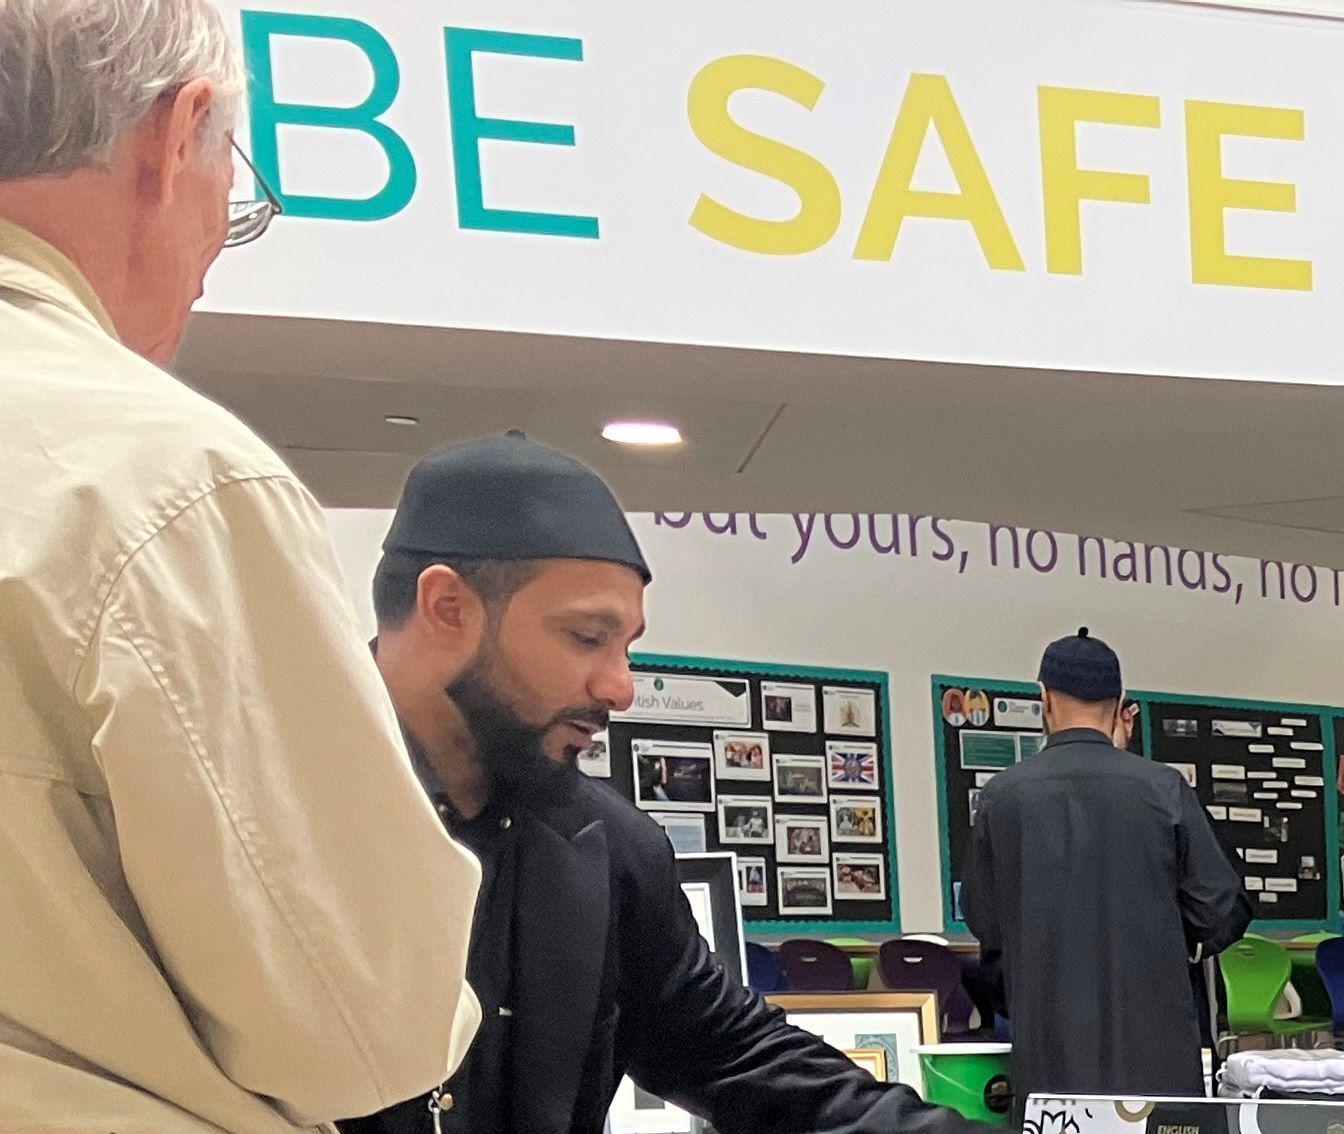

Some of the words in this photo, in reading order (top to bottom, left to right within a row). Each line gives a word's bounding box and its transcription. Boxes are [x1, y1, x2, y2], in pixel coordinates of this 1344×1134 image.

[240, 10, 600, 240] BE
[686, 53, 1313, 292] SAFE
[989, 523, 1058, 574] no
[1260, 558, 1318, 603] no
